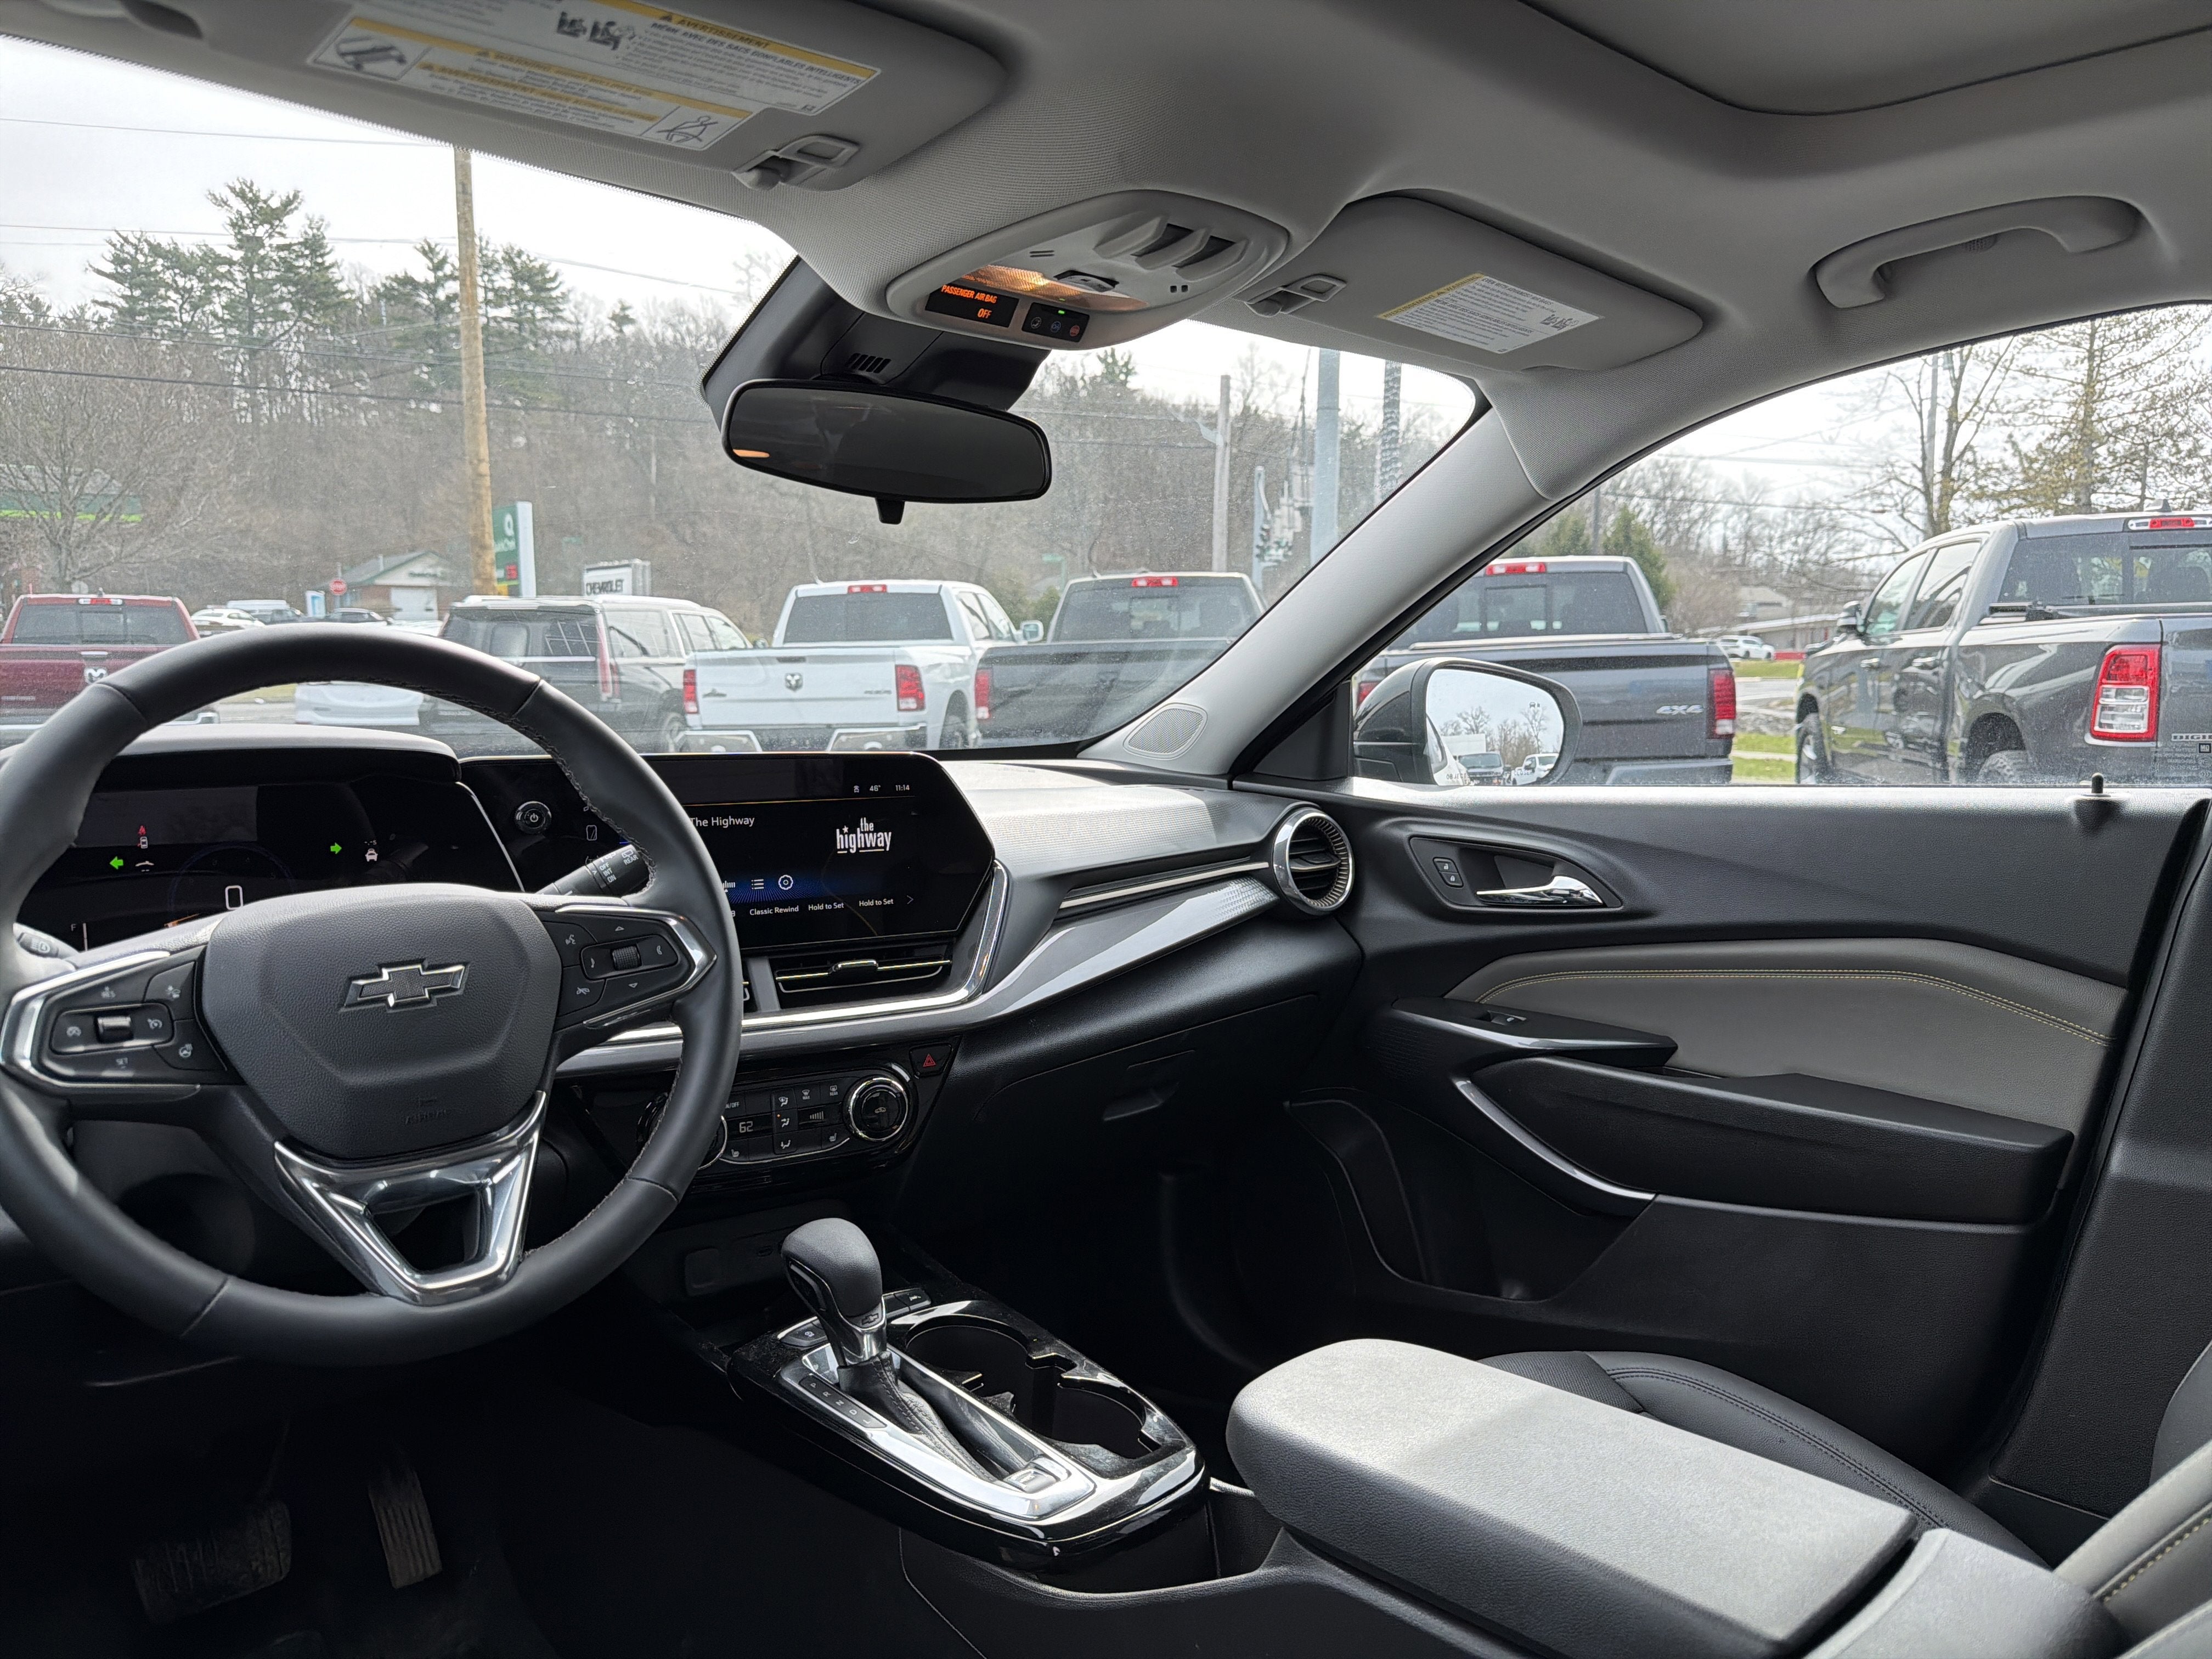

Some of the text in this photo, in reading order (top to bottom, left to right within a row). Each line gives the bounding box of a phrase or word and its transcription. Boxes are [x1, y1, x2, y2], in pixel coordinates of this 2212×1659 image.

[678, 18, 770, 48] AVERTISSEMENT
[682, 30, 703, 42] AVEC
[707, 37, 724, 47] DES
[941, 284, 975, 300] PASSENGER
[977, 308, 992, 319] OFF
[585, 578, 624, 596] CHEVROLET
[690, 815, 755, 828] The Highway
[860, 817, 874, 832] the
[836, 827, 892, 853] highway
[623, 854, 639, 865] REAR
[599, 862, 611, 871] OFF
[603, 867, 613, 877] INT
[607, 874, 617, 883] ON
[749, 905, 799, 916] Classic Rewind
[808, 903, 824, 911] Hold
[738, 1121, 754, 1133] 62
